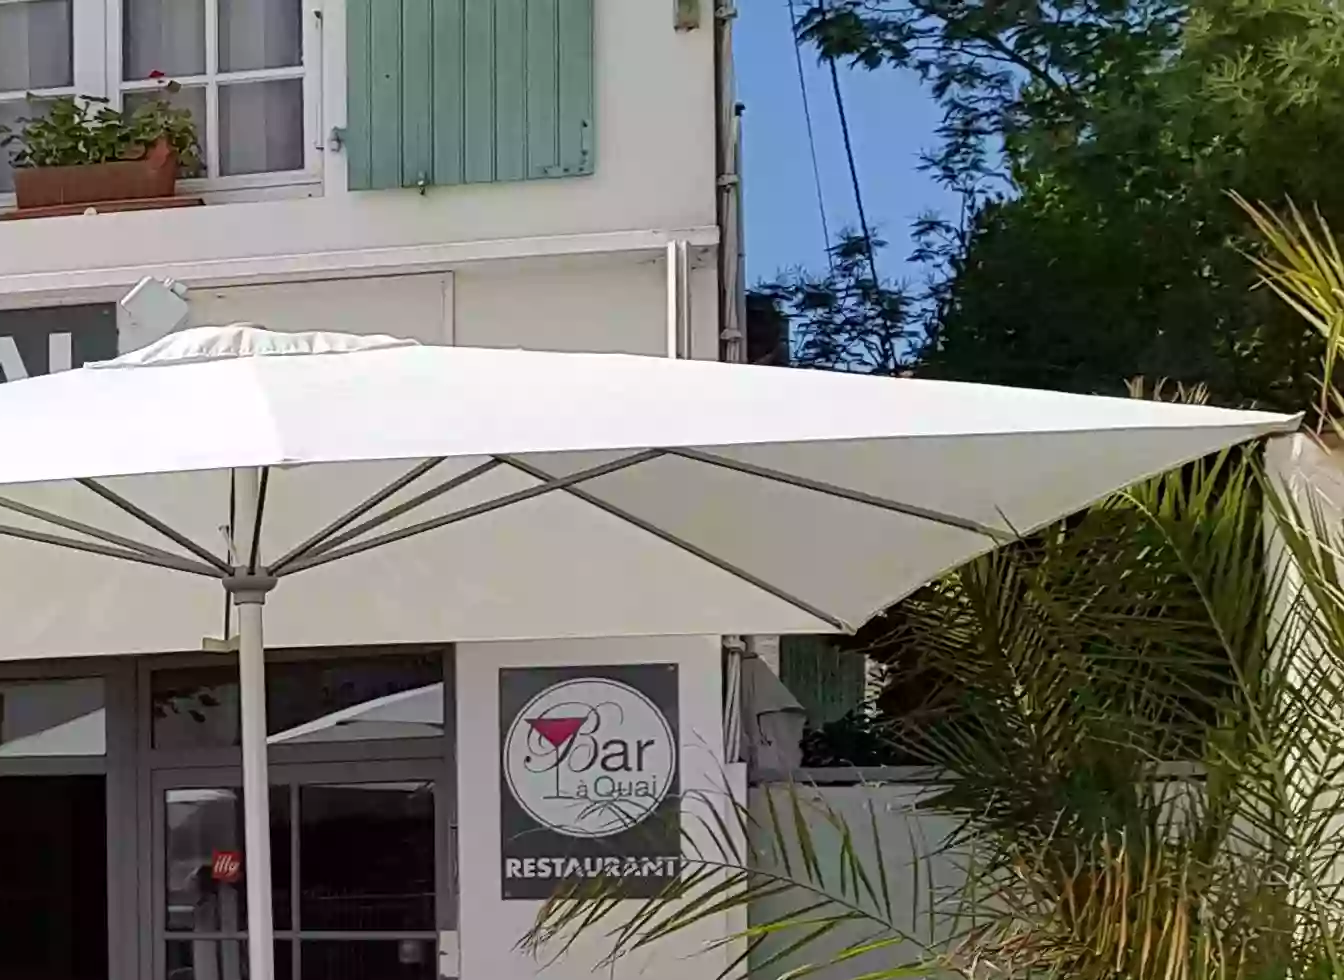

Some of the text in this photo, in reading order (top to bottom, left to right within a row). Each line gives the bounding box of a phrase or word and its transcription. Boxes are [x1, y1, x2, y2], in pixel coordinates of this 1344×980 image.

[524, 701, 655, 773] Bar
[593, 775, 658, 799] Quai
[214, 855, 241, 877] illy
[505, 857, 679, 879] RESTAURANT
